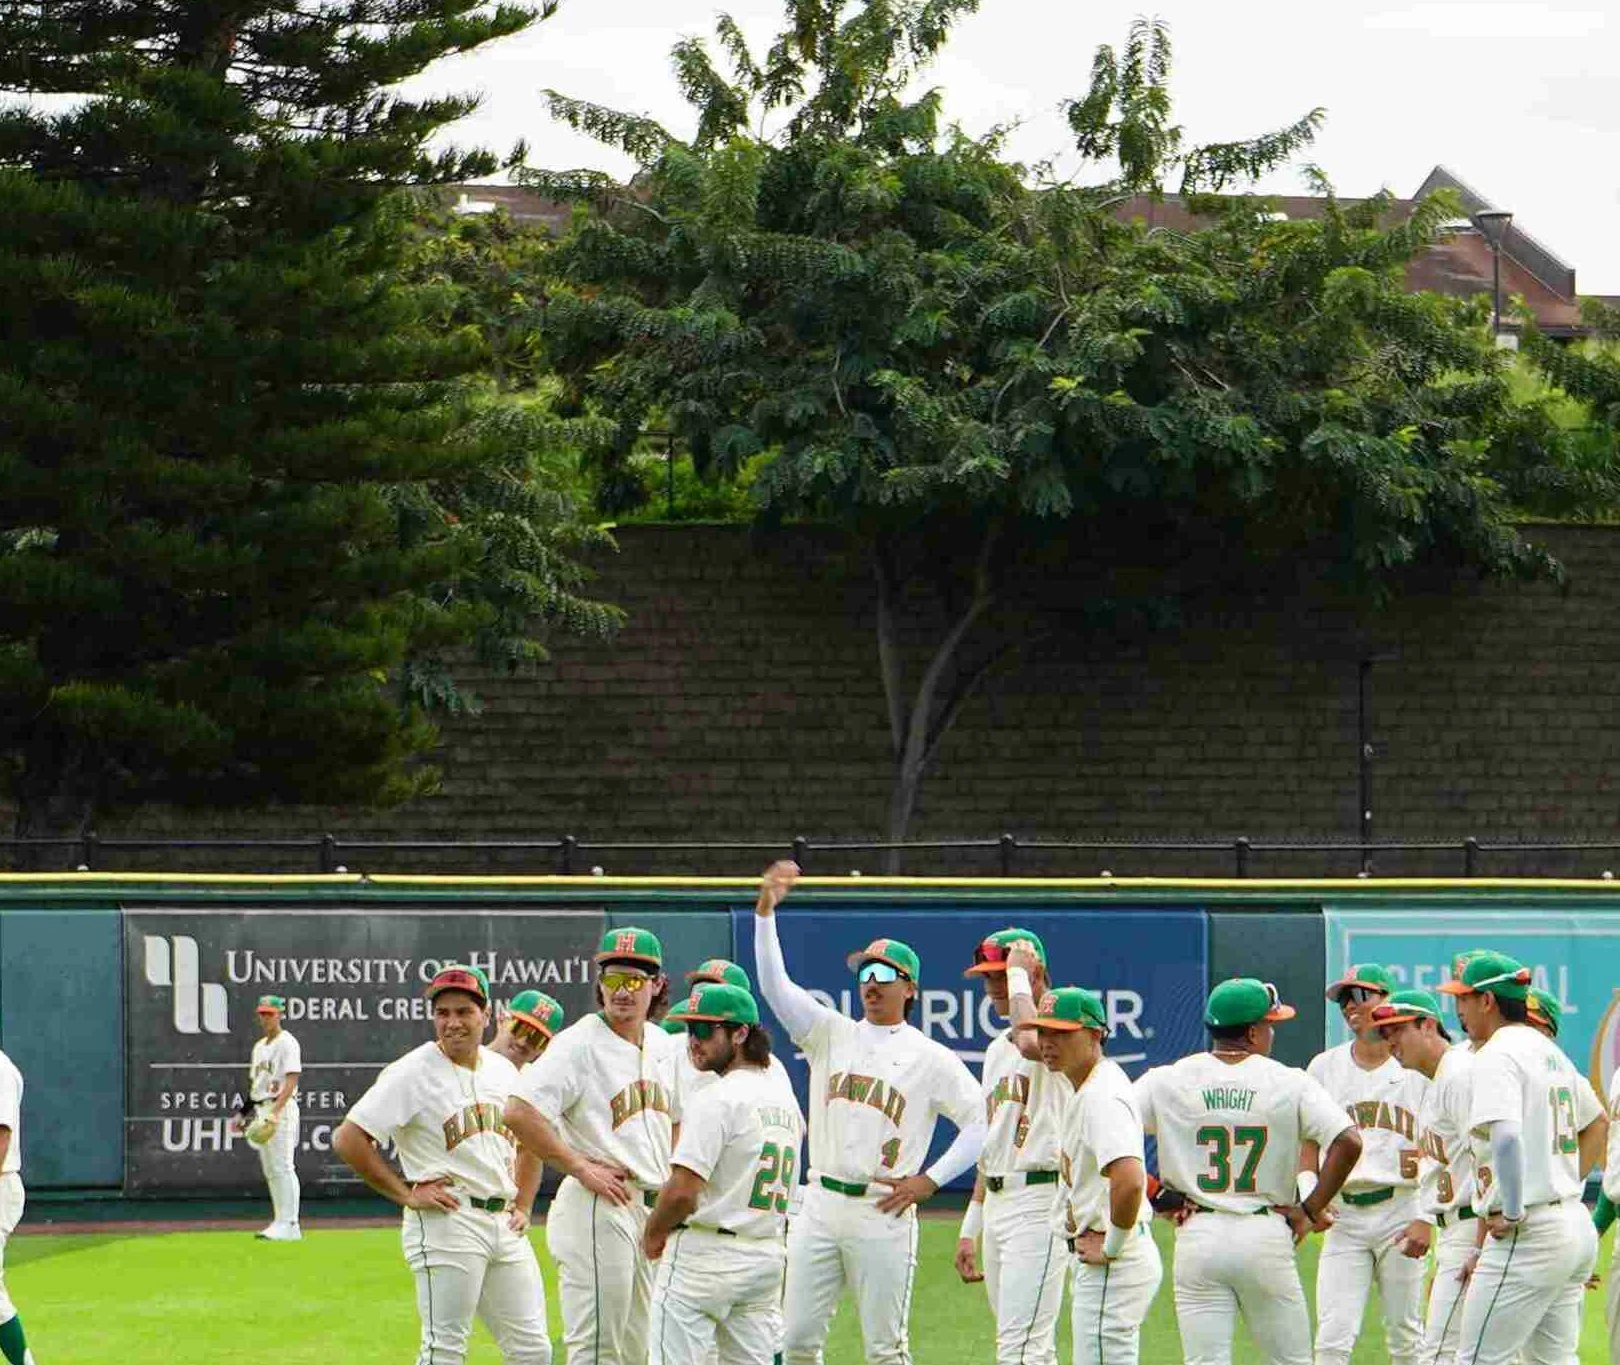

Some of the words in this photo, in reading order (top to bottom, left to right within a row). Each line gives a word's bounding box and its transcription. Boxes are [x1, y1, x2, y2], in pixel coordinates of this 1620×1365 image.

[226, 950, 412, 984] UNIVERSITY
[279, 998, 368, 1020] EDERAL
[161, 1091, 245, 1110] SPECIA
[1202, 1086, 1257, 1113] WRIGHT
[1195, 1124, 1269, 1194] 37
